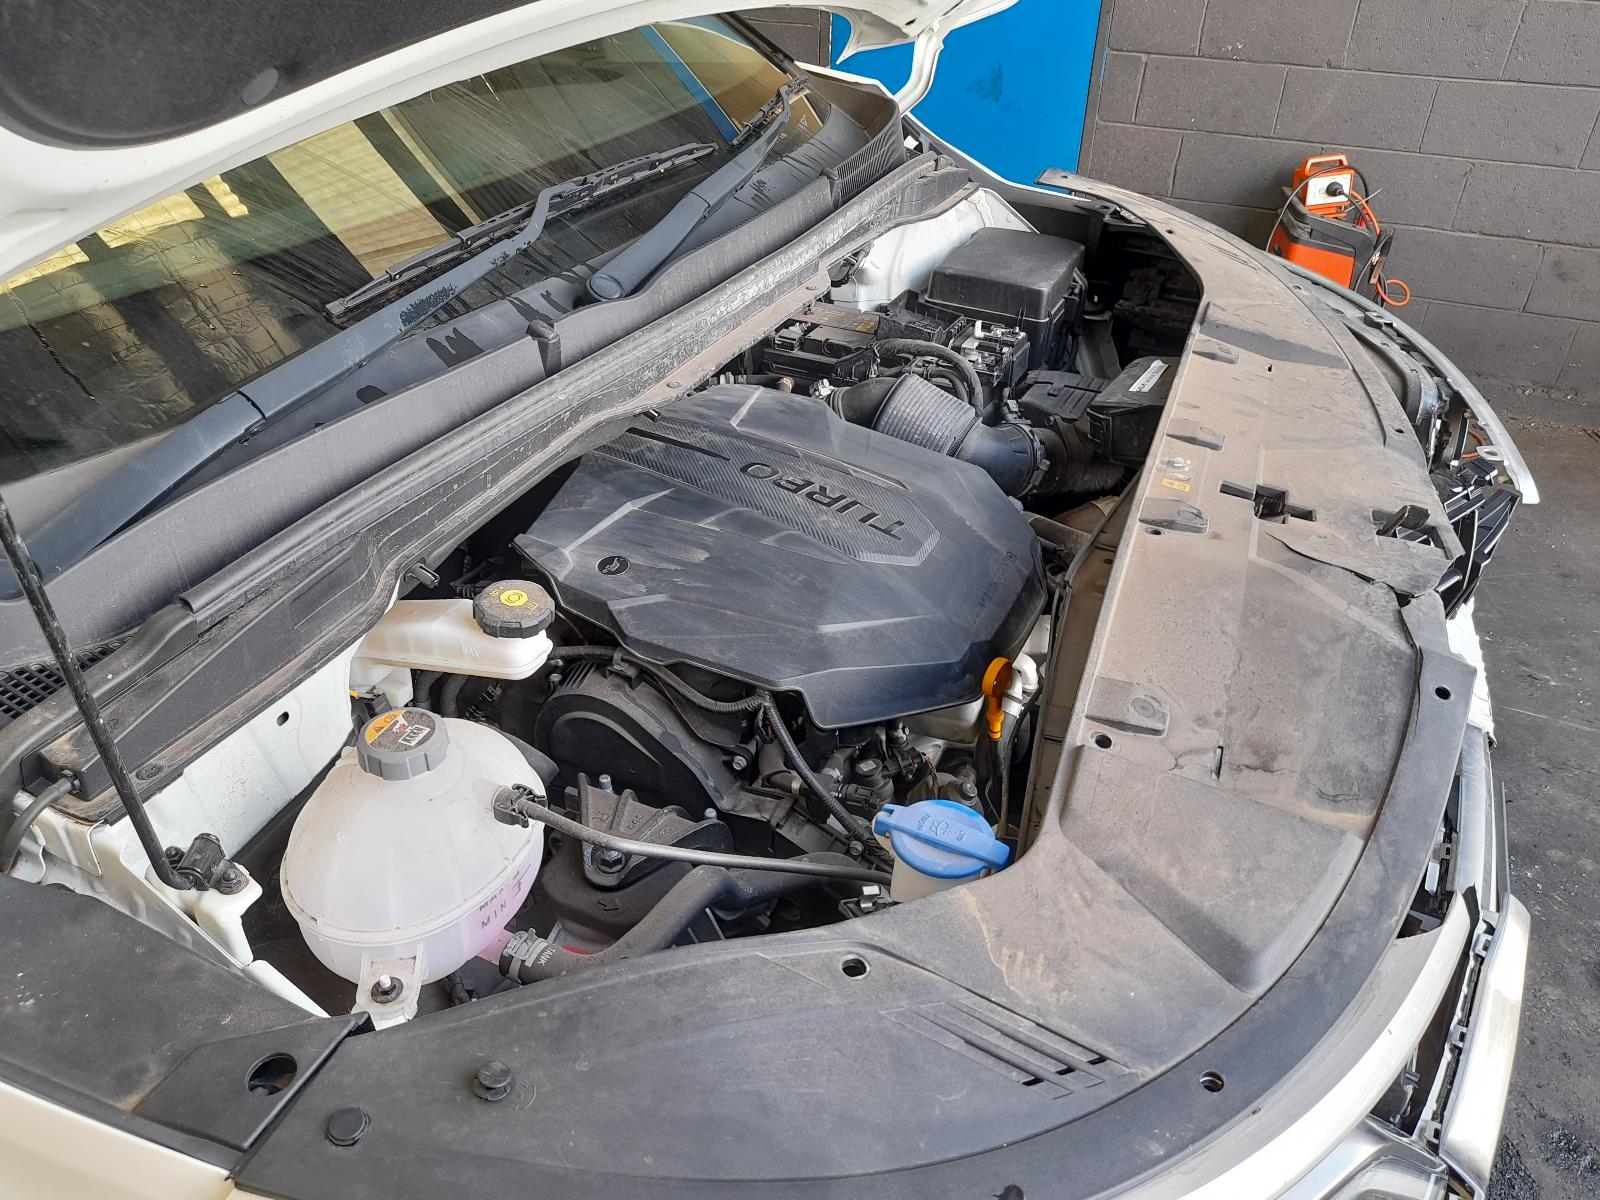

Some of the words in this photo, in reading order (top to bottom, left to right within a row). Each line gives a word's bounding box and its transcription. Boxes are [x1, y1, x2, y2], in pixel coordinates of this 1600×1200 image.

[739, 462, 905, 541] TURBO
[481, 899, 507, 929] MIN
[538, 947, 556, 966] TANK
